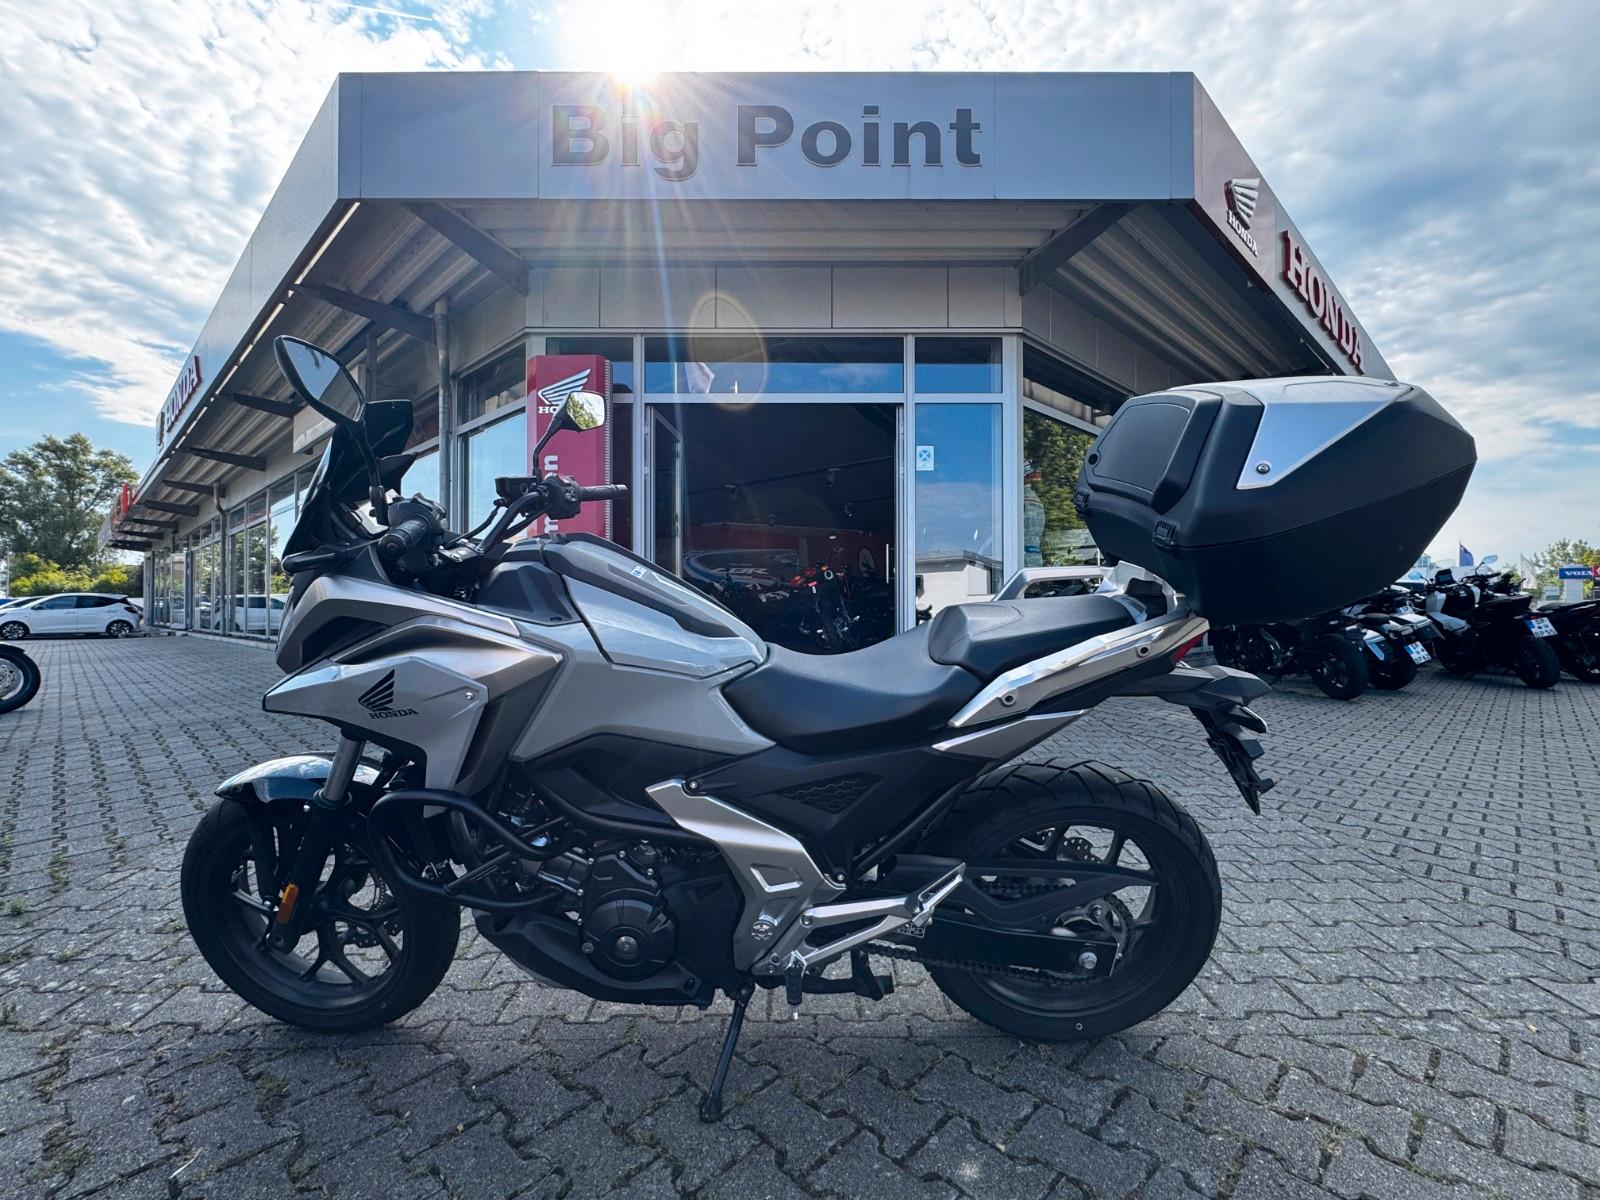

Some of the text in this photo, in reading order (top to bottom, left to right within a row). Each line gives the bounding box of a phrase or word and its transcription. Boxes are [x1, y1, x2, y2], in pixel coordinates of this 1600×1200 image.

[551, 103, 983, 182] Big Point
[1227, 210, 1259, 256] HONDA
[1282, 230, 1364, 375] HONDA
[164, 355, 202, 433] HONDA
[368, 708, 419, 719] HONDA
